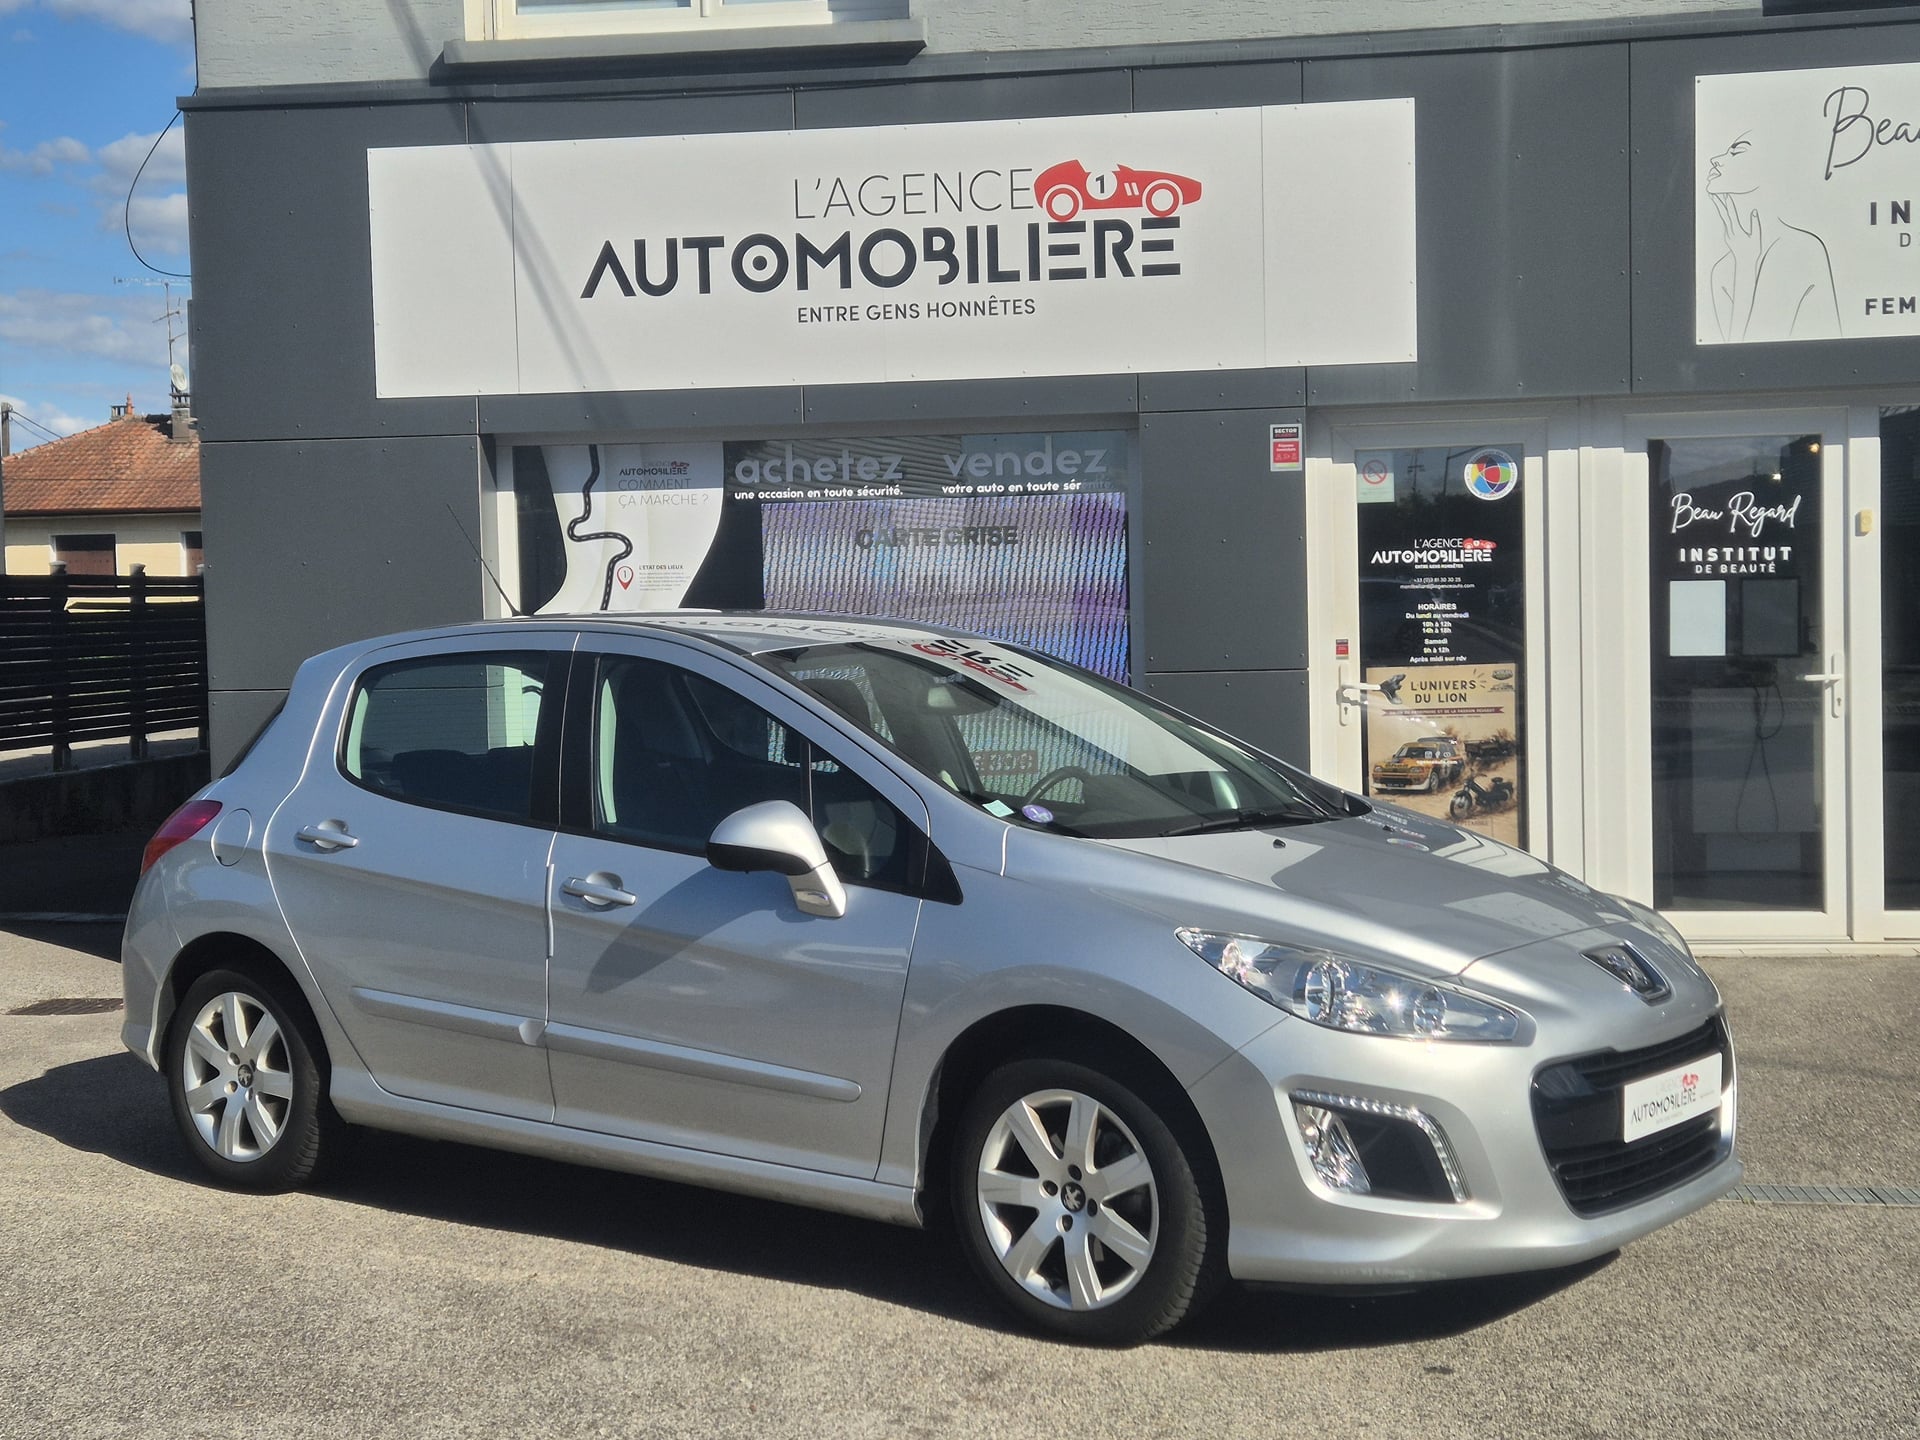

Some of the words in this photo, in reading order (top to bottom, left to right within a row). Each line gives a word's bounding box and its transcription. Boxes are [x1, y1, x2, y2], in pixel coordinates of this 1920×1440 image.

[1824, 86, 1920, 180] Bea
[794, 168, 1034, 219] L'AGENCE
[798, 304, 860, 323] ENTRE
[866, 302, 921, 321] GENS
[926, 295, 1037, 319] HONNÊTES
[735, 443, 903, 484] achetez
[942, 435, 1109, 477] vendez
[618, 478, 692, 491] COMMENT
[735, 491, 755, 500] une
[758, 487, 804, 499] occasion
[807, 490, 821, 498] en
[823, 488, 854, 498] toute
[857, 484, 904, 497] sécurité.
[942, 483, 973, 494] votre
[976, 482, 1005, 493] auto
[1008, 483, 1024, 492] en
[1027, 481, 1060, 492] toute
[618, 494, 636, 509] ÇA
[640, 493, 698, 506] MARCHE
[702, 493, 709, 504] ?
[1671, 493, 1723, 533] Beau
[1728, 491, 1802, 537] Regard
[1414, 538, 1464, 549] L'AGENCE
[1680, 547, 1792, 562] INSTITUT
[1695, 564, 1713, 574] DE
[1720, 561, 1776, 574] BEAUTÉ
[1415, 693, 1431, 703] DU
[1438, 693, 1467, 703] LION
